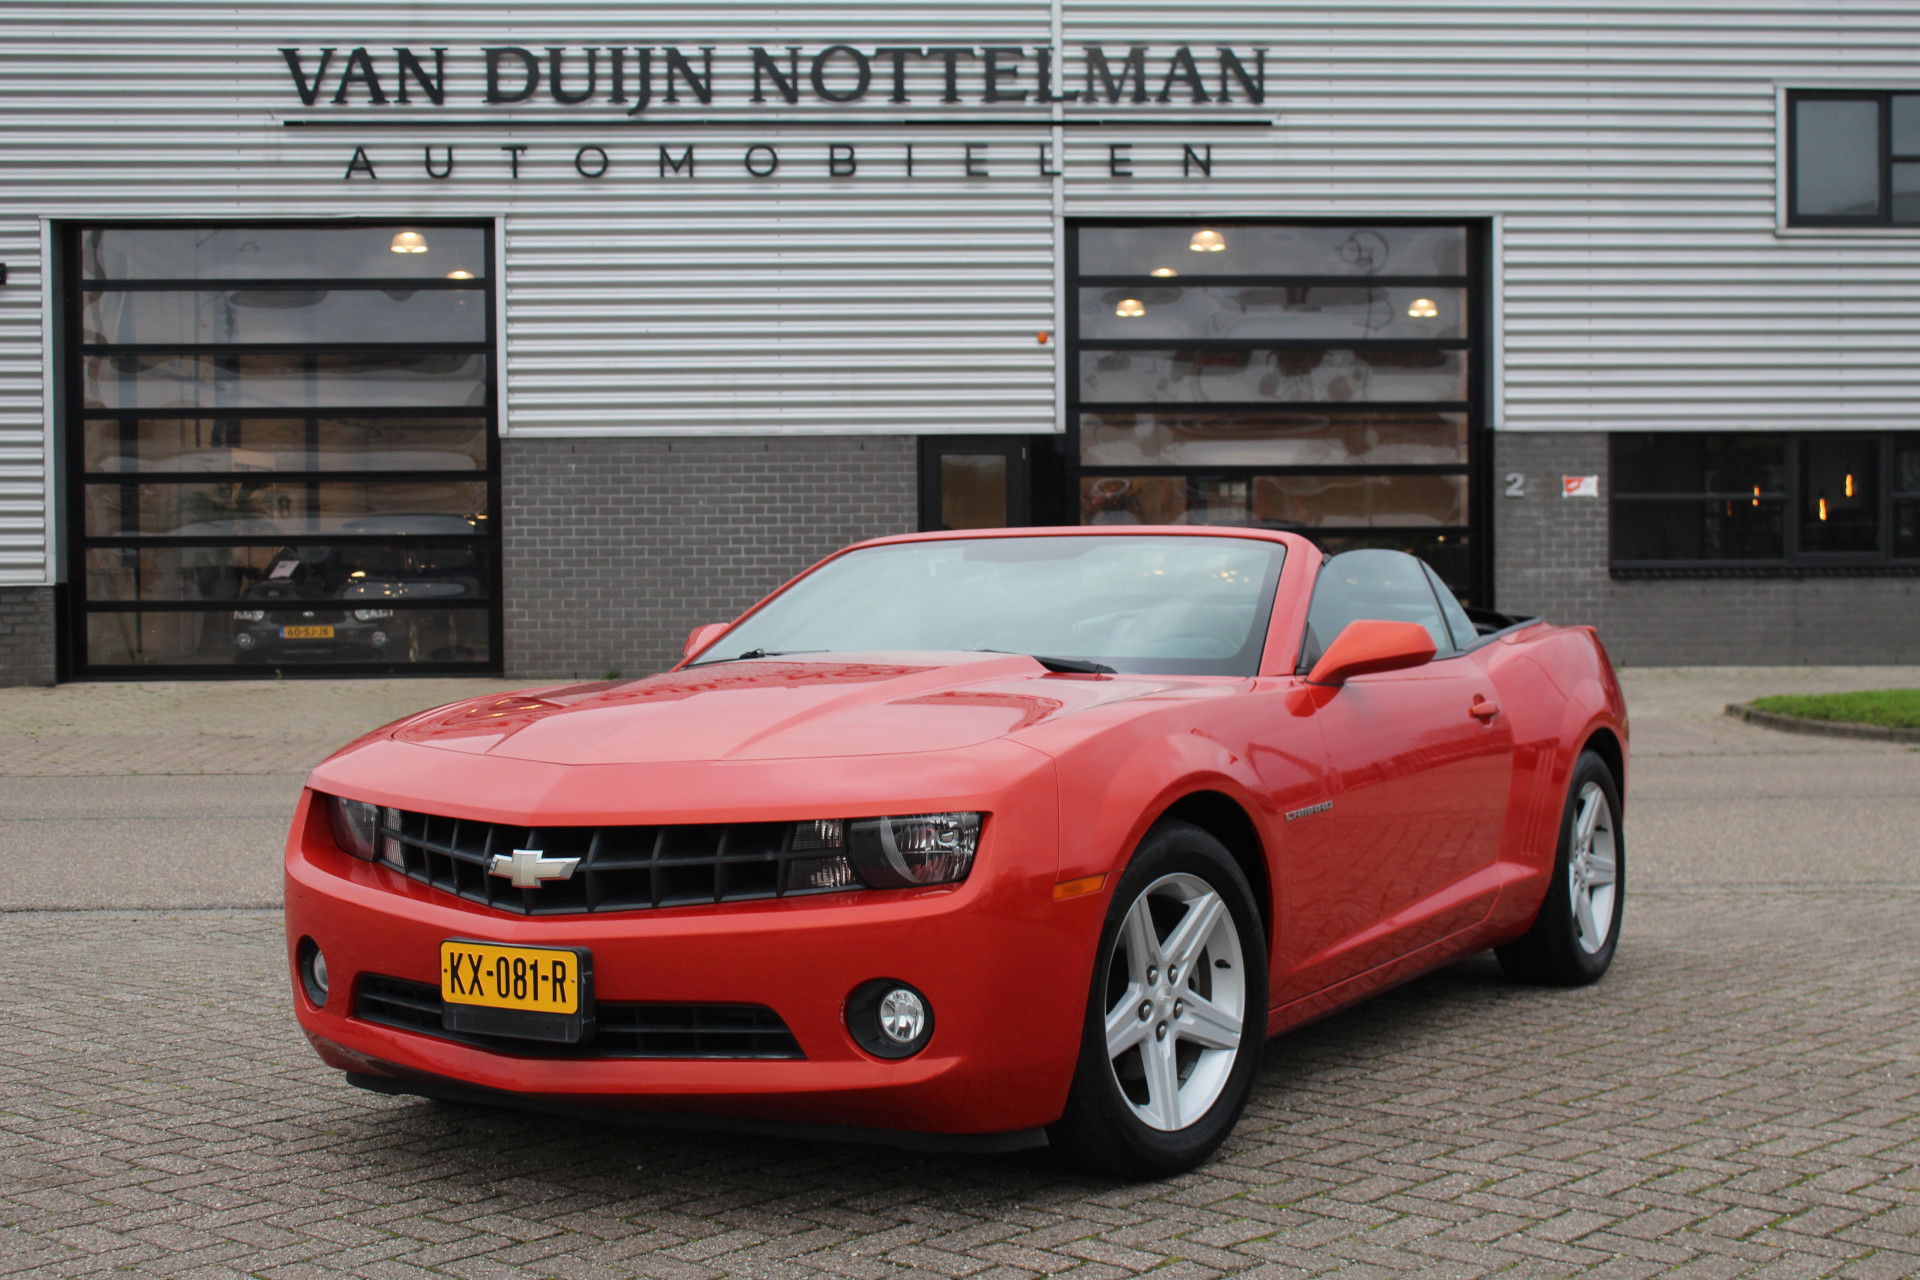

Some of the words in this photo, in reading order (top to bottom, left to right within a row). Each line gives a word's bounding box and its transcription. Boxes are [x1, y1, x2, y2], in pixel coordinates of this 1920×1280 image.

[278, 47, 448, 106] VAN
[481, 47, 717, 116] DUIJN
[747, 45, 1269, 104] NOTTELMAN
[344, 144, 1213, 180] AUTOMOBIELEN
[1505, 472, 1525, 497] 2
[449, 952, 567, 1003] KX-081-R
